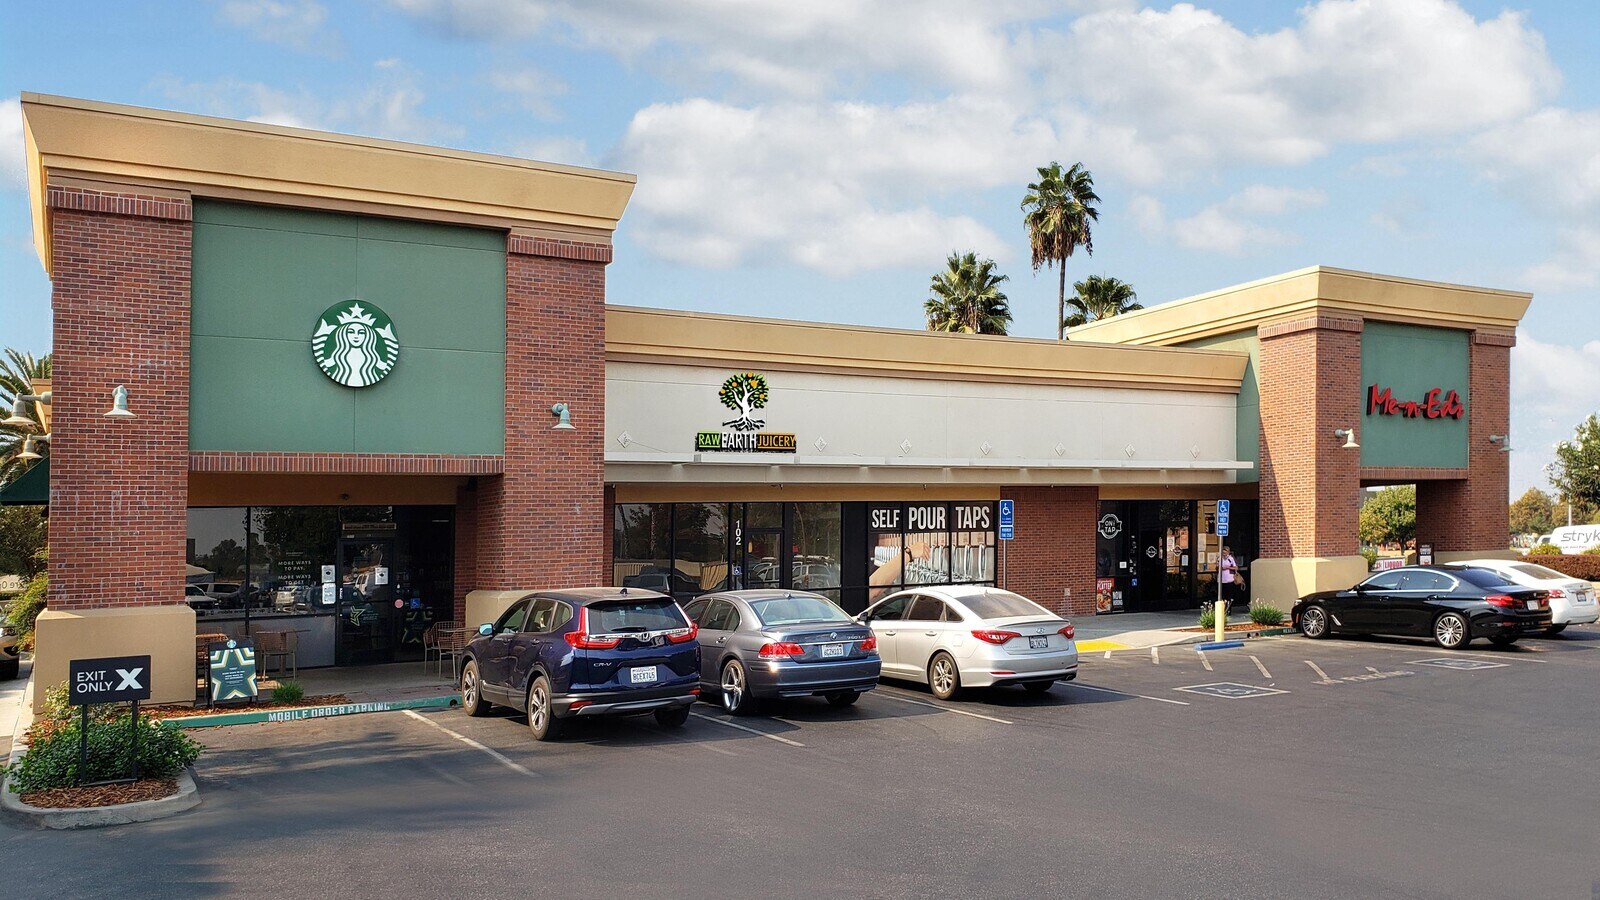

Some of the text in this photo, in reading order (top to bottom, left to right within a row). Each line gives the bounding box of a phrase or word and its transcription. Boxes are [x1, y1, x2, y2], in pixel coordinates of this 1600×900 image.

[698, 432, 796, 449] RAW EARTH JUICERY
[871, 506, 990, 530] SELF POUR TAPS
[1384, 560, 1403, 569] LIQUOR
[77, 670, 107, 682] EXIT
[76, 681, 113, 693] ONLY
[268, 701, 391, 722] MOBILE ORDER PARKING
